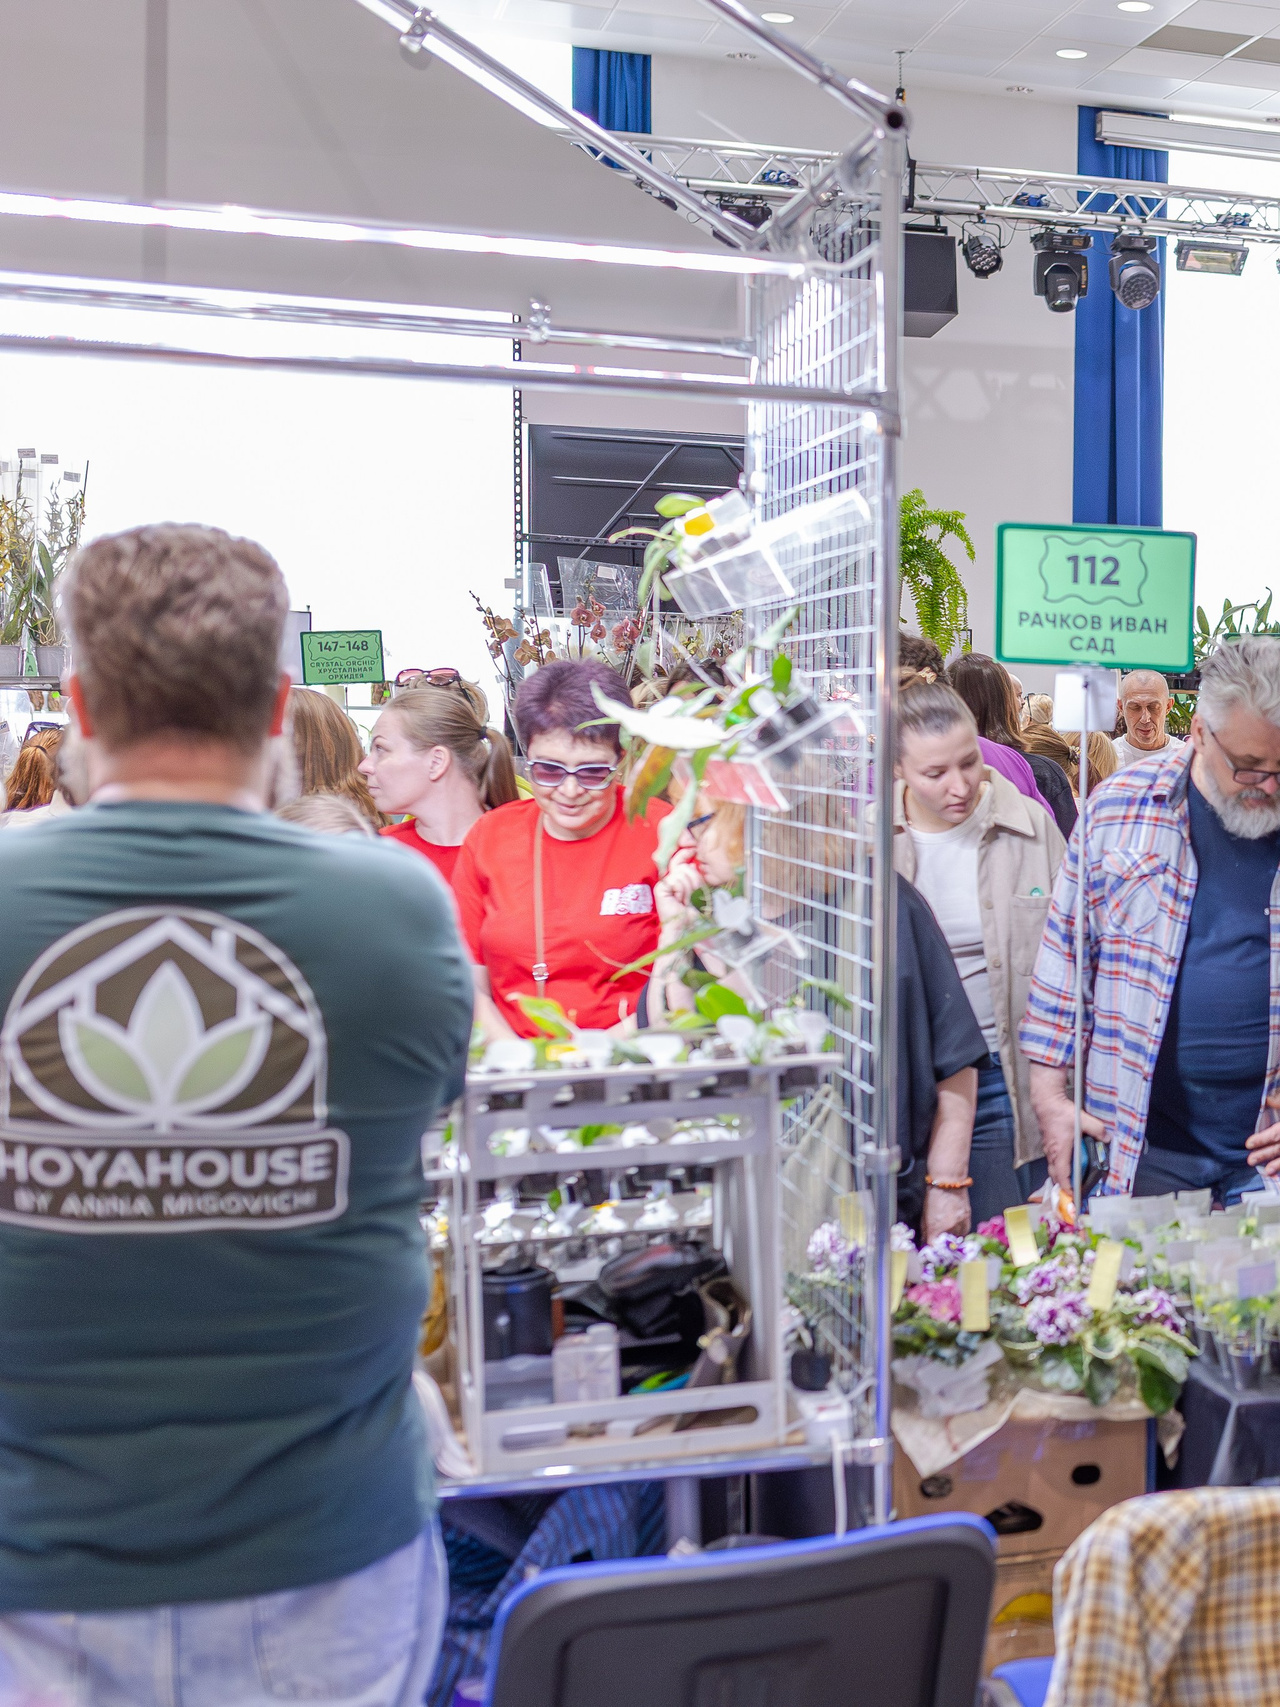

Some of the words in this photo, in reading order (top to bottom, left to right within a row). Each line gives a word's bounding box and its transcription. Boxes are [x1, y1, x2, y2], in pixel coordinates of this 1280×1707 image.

[1067, 555, 1119, 585] 112
[1018, 611, 1102, 630] РАЧКОВ
[1110, 617, 1167, 634] ИВАН
[317, 640, 369, 652] 147-148
[1069, 636, 1115, 655] САД
[318, 666, 373, 674] ХРУСТАЛЬНАЯ
[0, 1144, 332, 1189] HOYAHOUSE
[13, 1187, 54, 1214] BY
[60, 1195, 156, 1219] ANNA
